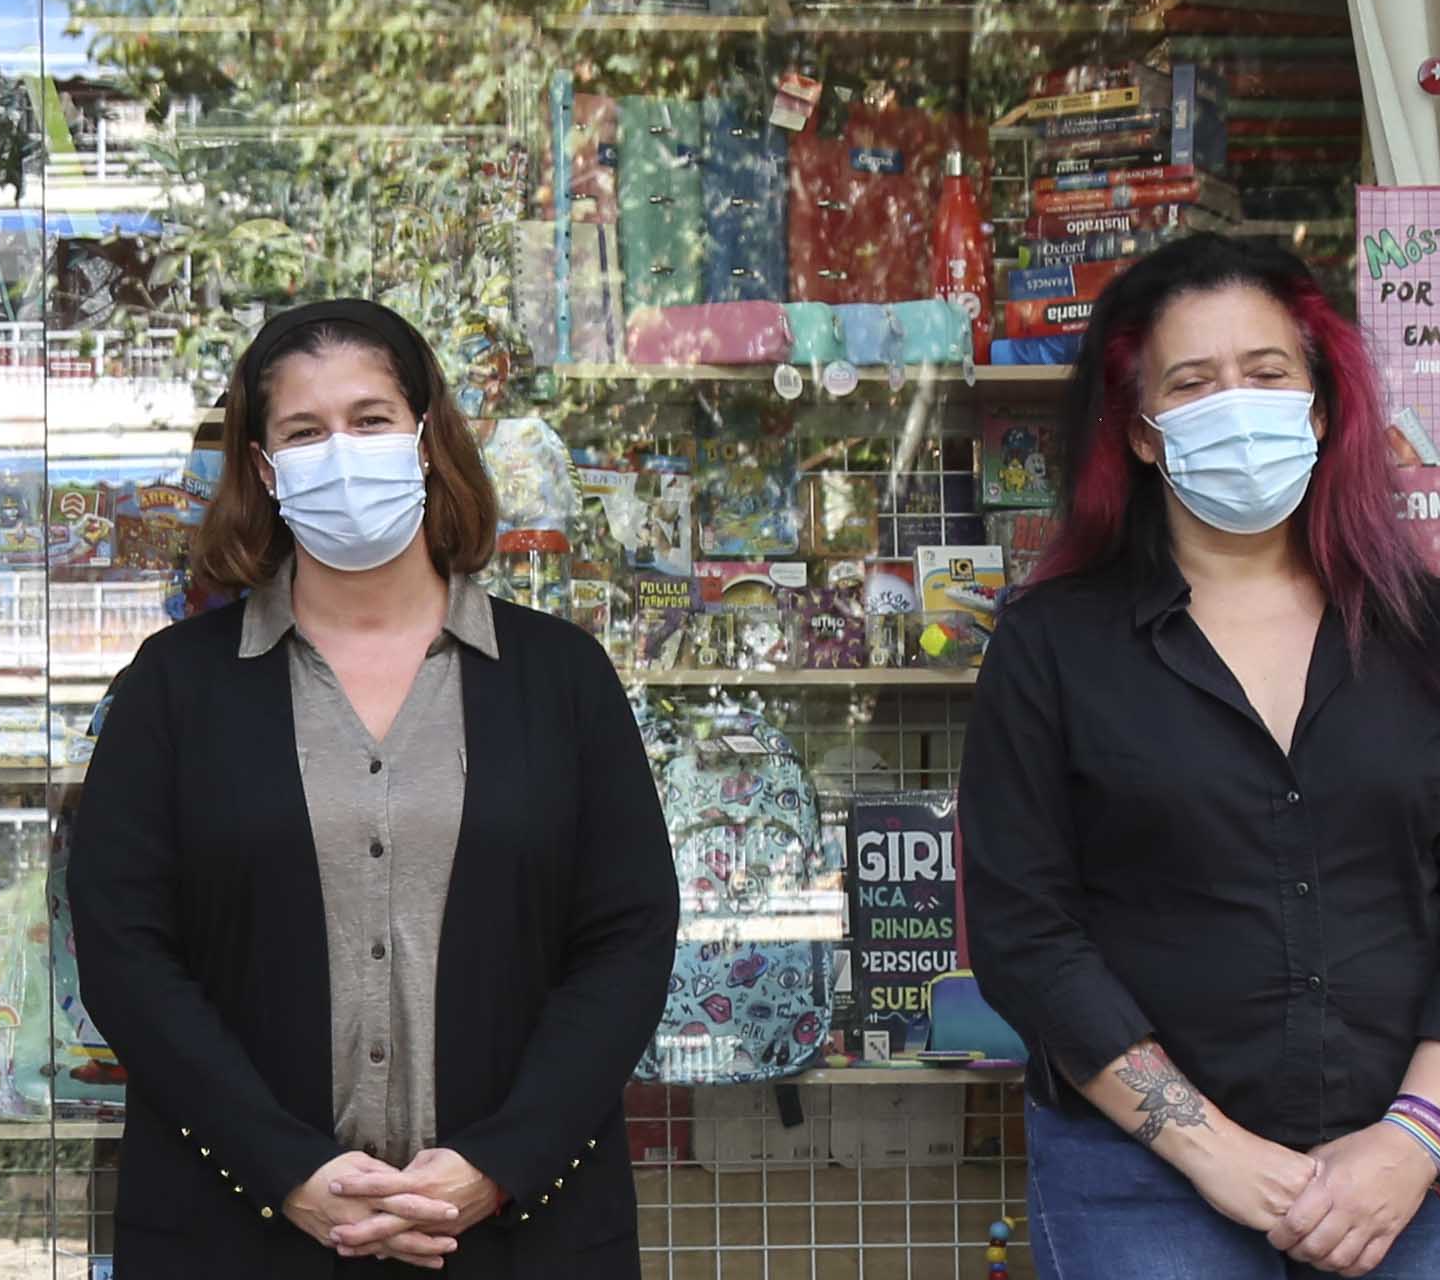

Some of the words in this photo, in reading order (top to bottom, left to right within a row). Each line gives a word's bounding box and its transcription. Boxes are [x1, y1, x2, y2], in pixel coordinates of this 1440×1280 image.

[1380, 279, 1434, 306] POR
[639, 581, 689, 594] POLILLA
[857, 830, 956, 882] GIRL
[871, 917, 953, 940] RINDAS
